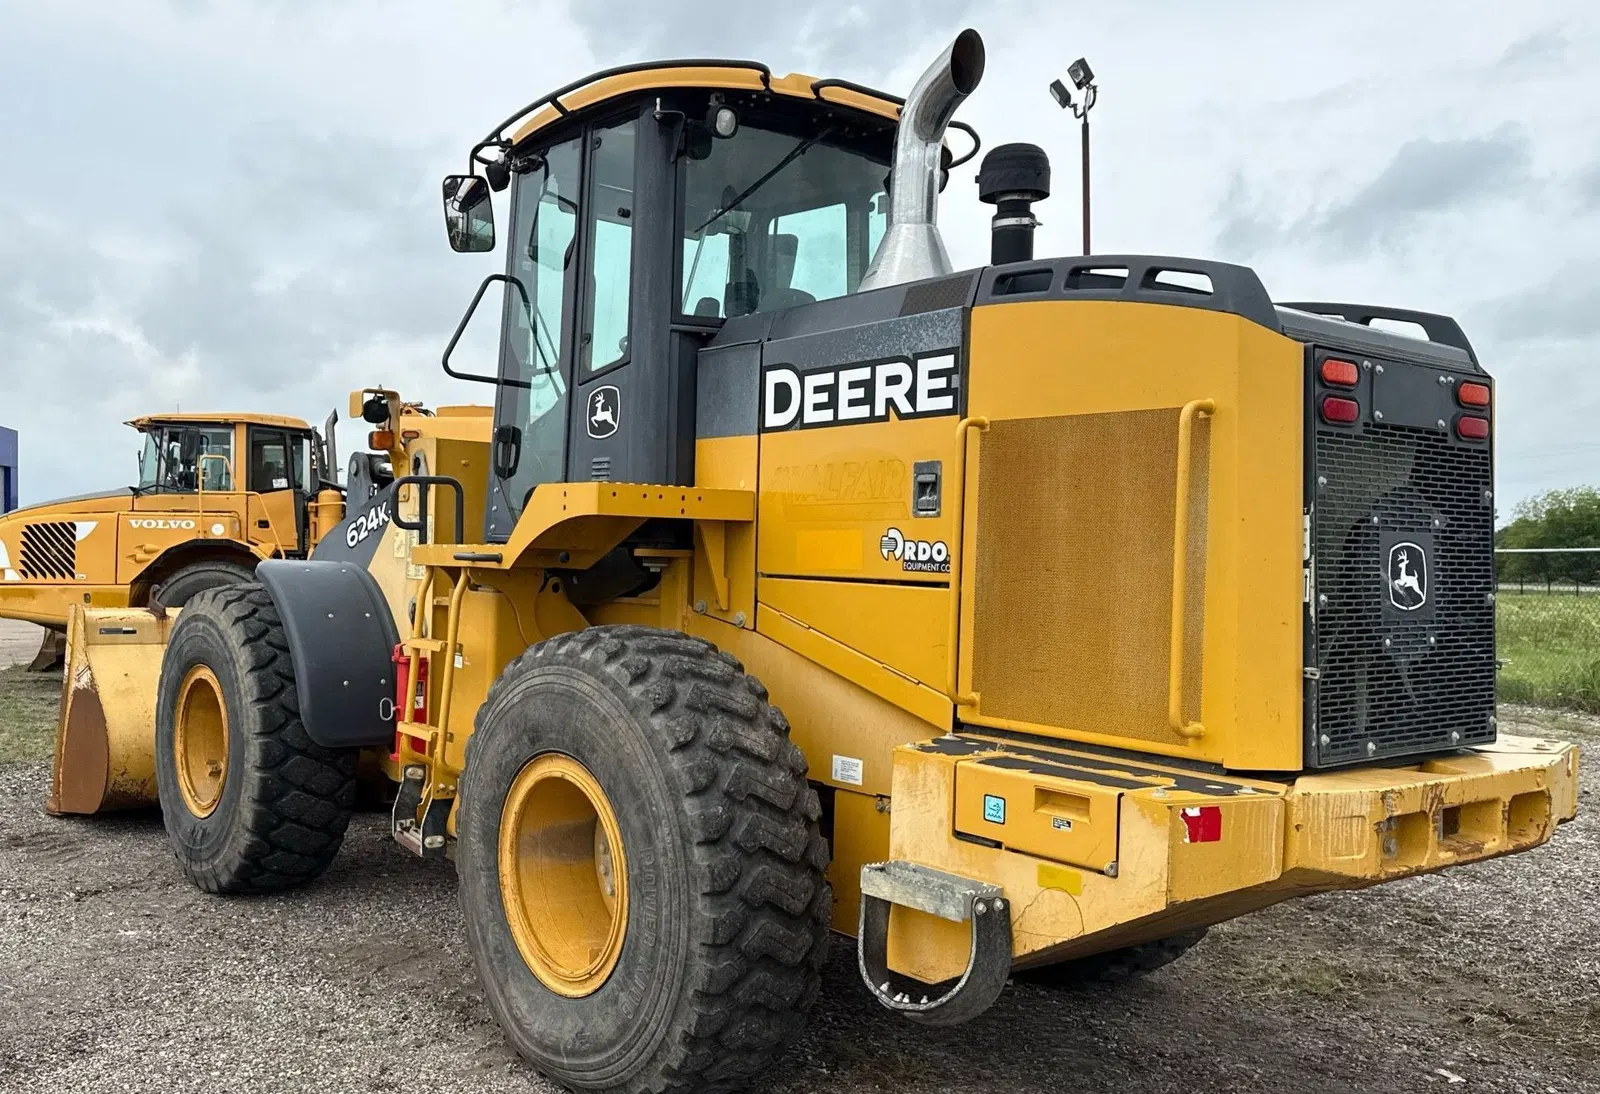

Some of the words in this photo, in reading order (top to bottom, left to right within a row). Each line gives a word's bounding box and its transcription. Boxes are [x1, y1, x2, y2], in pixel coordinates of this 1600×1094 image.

[764, 354, 955, 428] DEERE
[128, 519, 196, 530] VOLVO
[903, 561, 940, 572] EQUIPMENT
